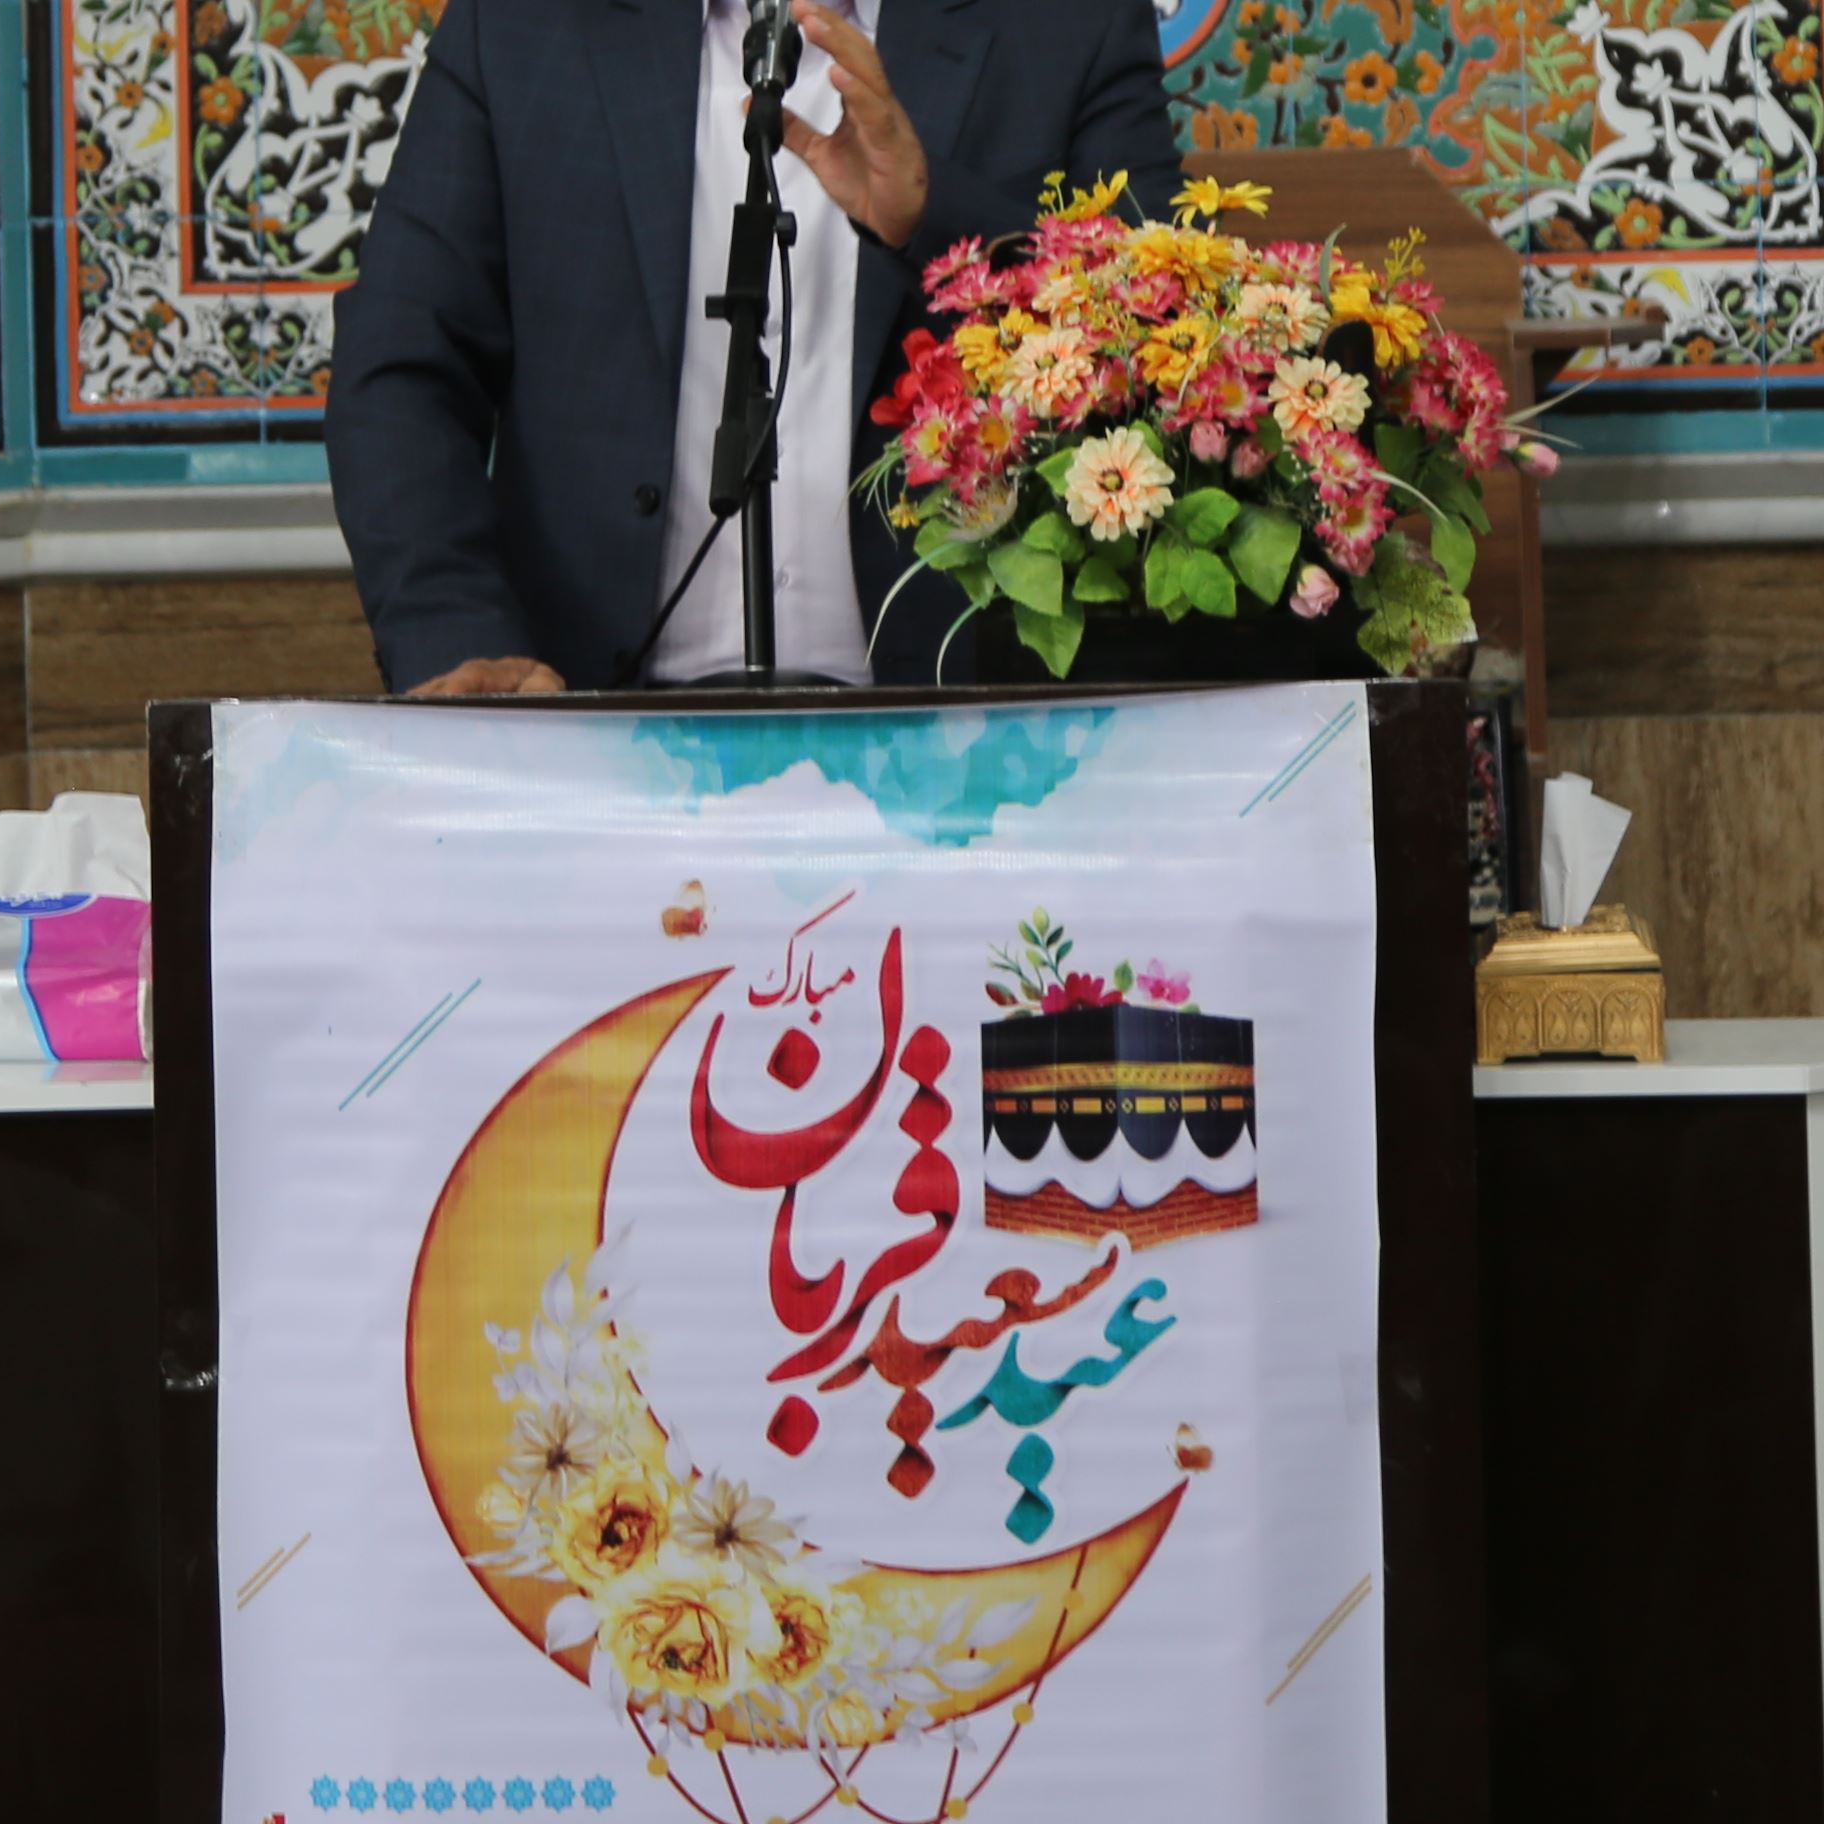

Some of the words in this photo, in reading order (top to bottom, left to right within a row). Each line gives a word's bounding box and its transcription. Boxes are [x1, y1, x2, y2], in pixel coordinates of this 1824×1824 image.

[746, 888, 857, 1026] مبارک
[688, 923, 962, 1460] قربان
[816, 1243, 1120, 1500] سعید
[934, 1276, 1177, 1546] عید
